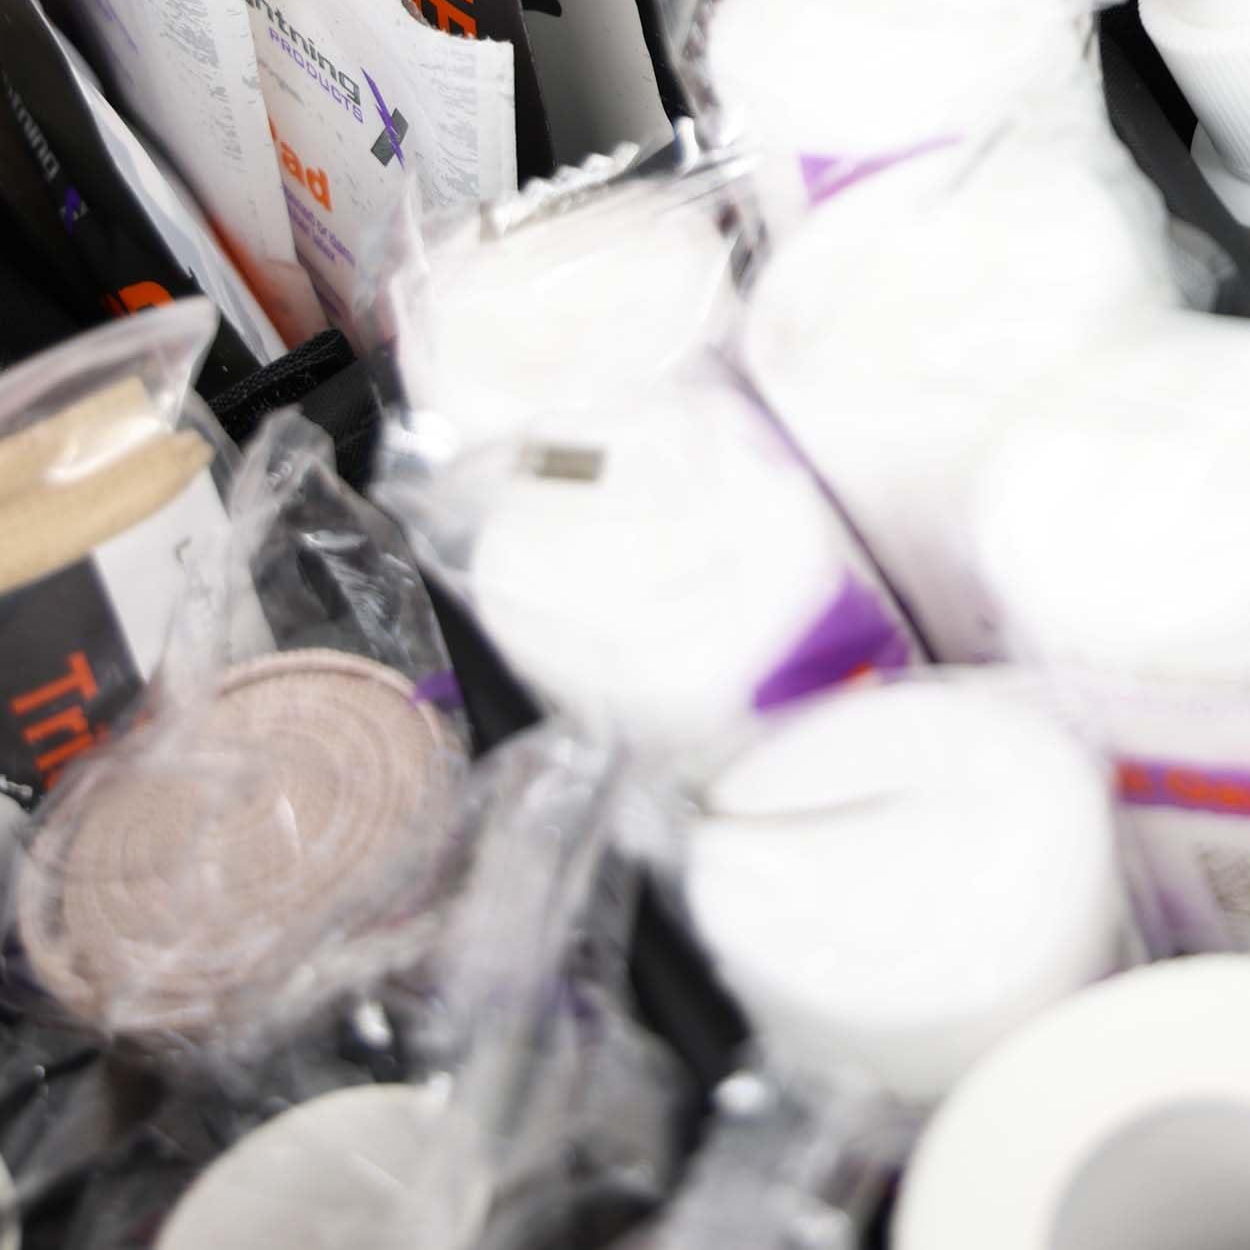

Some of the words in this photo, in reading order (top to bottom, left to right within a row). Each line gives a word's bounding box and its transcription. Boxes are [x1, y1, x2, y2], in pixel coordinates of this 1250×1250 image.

[268, 26, 364, 124] PRODUCTS
[269, 116, 333, 213] ad
[8, 647, 112, 792] Tri
